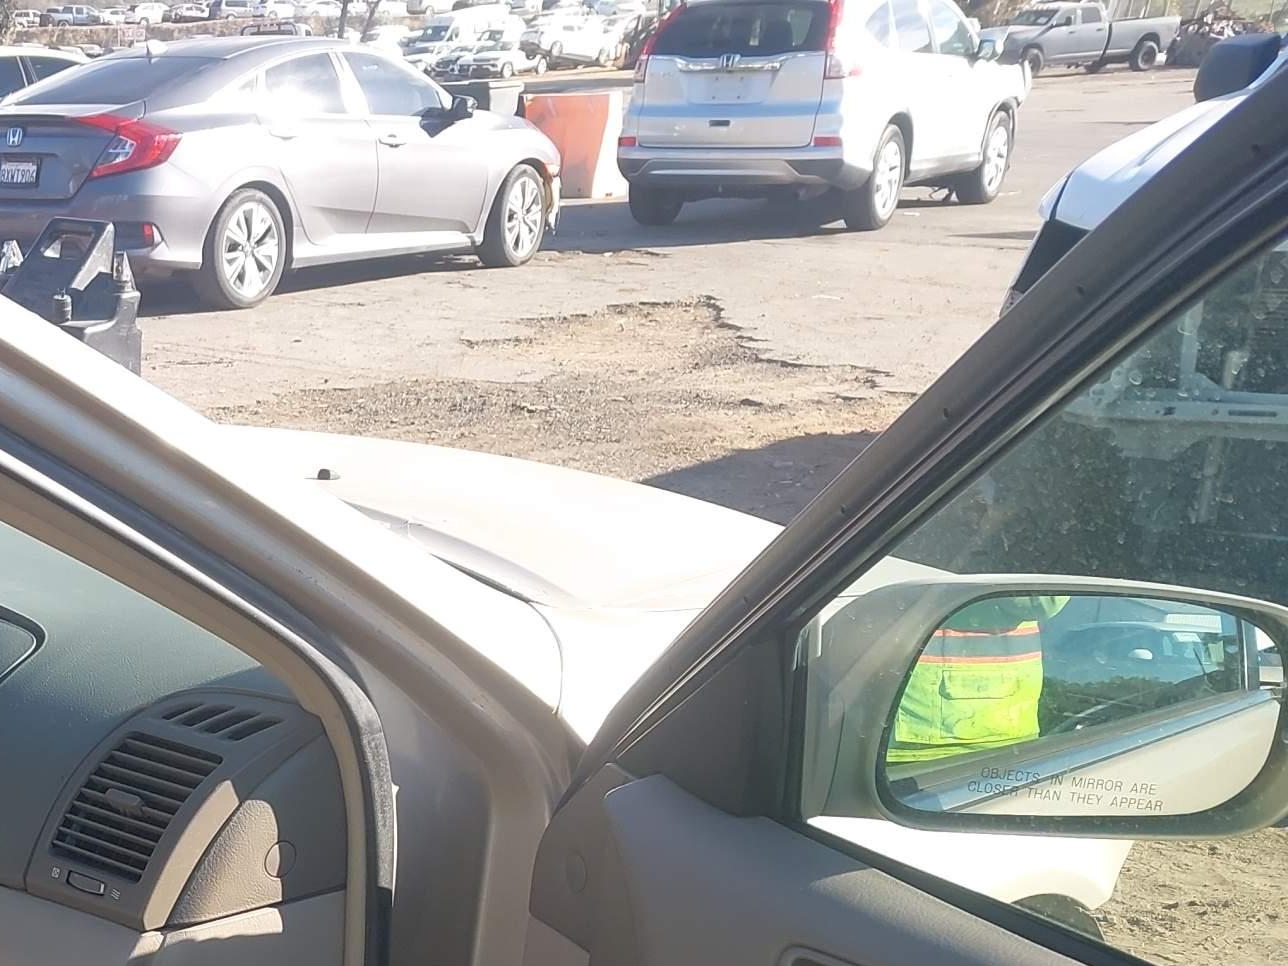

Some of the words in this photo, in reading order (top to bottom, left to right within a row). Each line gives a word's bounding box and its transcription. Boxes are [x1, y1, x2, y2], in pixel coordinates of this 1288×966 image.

[981, 767, 1041, 783] OBJECTS
[1050, 774, 1064, 786] IN
[1071, 776, 1123, 793] MIRROR
[1130, 783, 1159, 796] ARE
[1025, 786, 1062, 801] THAN
[1070, 791, 1103, 806] THEY
[1110, 796, 1164, 812] APPEAR
